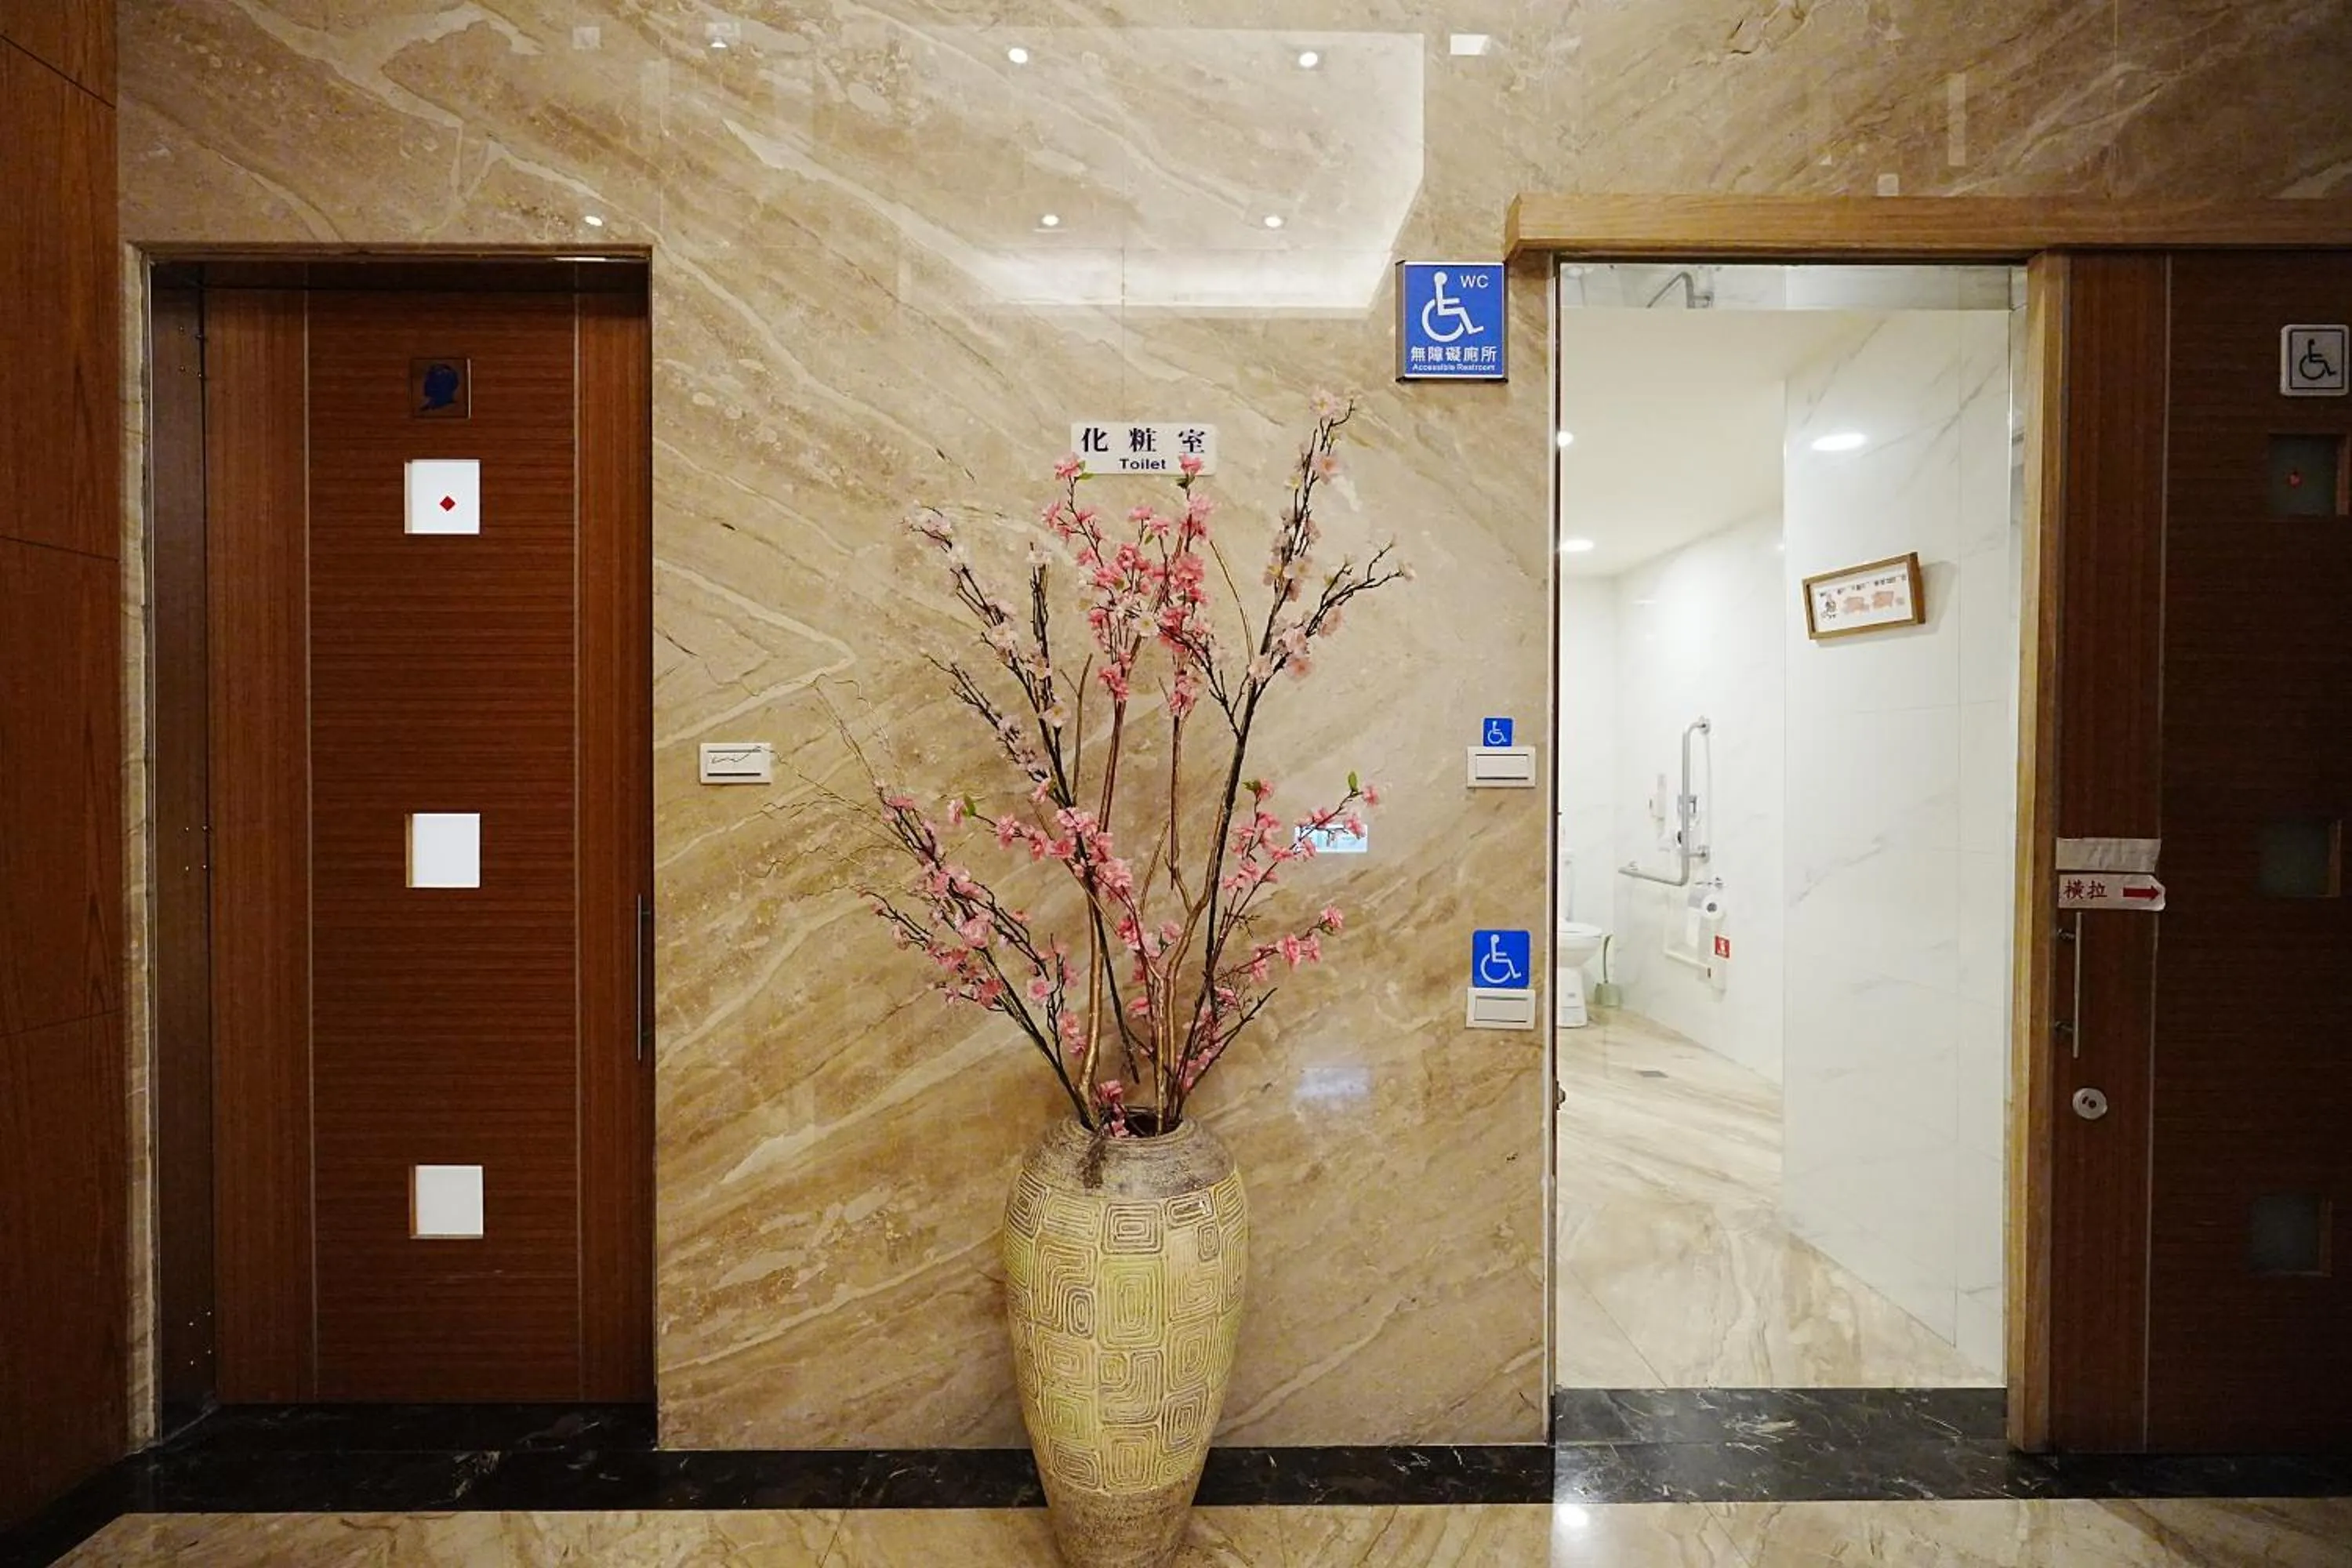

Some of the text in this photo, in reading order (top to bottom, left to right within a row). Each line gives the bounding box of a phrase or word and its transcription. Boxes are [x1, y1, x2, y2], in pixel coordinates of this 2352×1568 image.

[1461, 275, 1489, 288] WC
[1411, 346, 1497, 361] 無障礙廁所
[1120, 458, 1167, 470] Toilet
